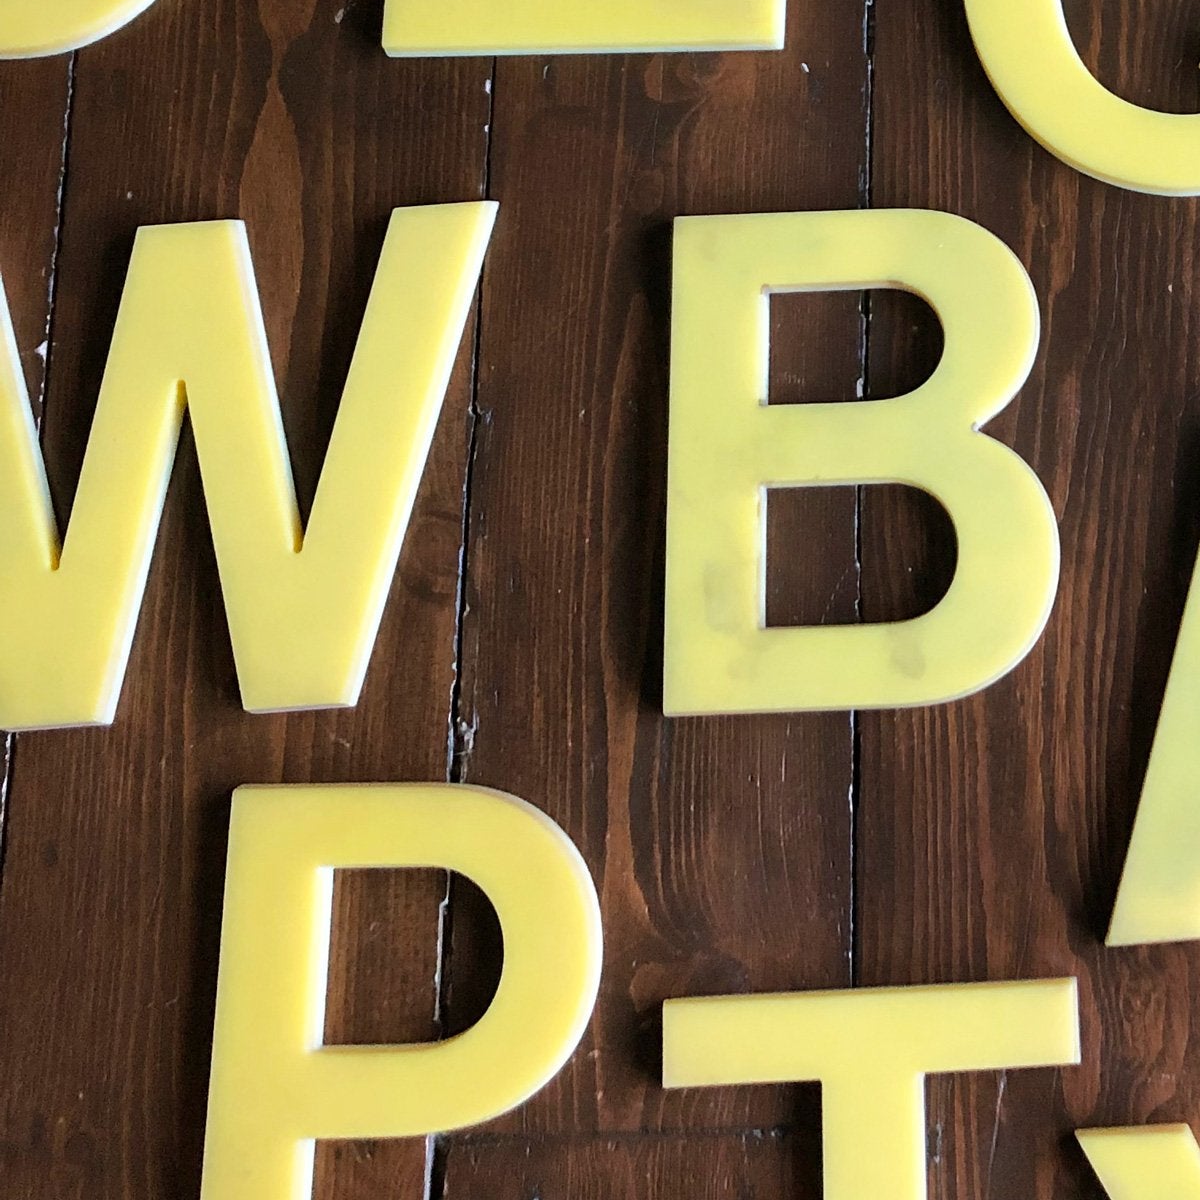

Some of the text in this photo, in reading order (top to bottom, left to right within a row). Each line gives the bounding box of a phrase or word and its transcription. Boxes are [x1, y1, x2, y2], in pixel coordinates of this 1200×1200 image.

[0, 201, 498, 733] W
[663, 208, 1061, 717] B
[201, 783, 604, 1200] P
